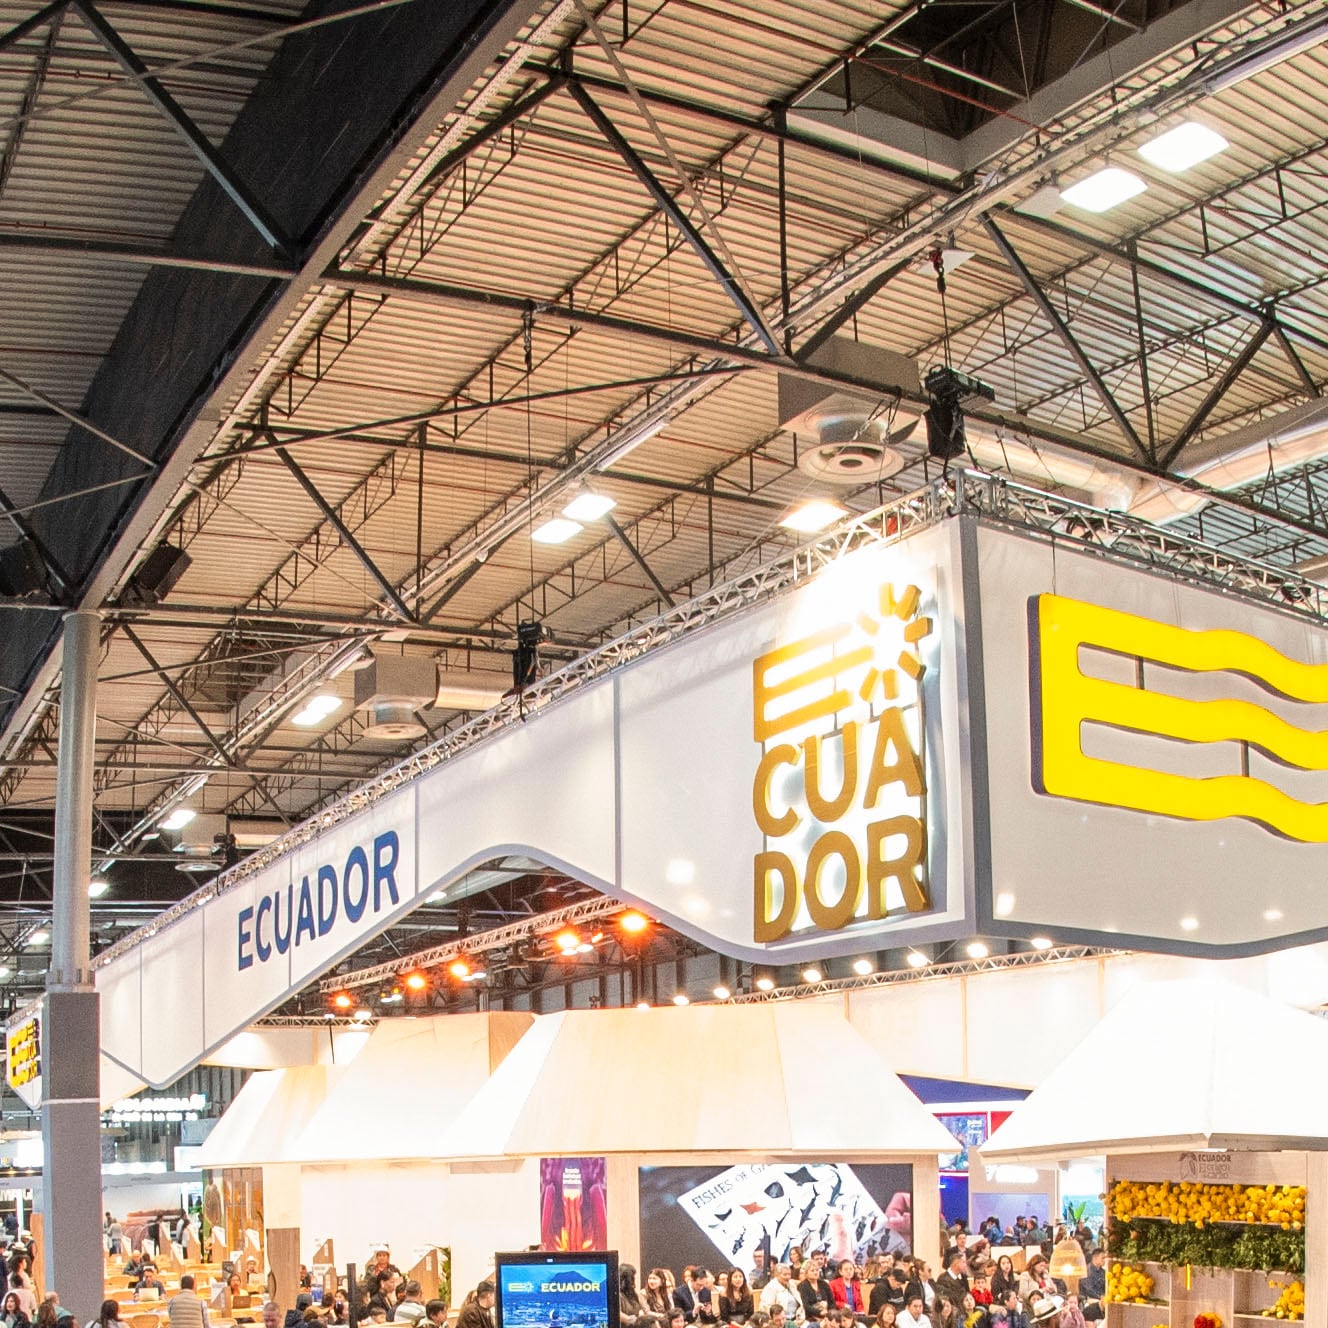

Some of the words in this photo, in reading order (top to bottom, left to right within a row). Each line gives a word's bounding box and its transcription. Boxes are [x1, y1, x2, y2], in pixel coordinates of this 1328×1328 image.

[754, 706, 927, 836] CUA
[238, 831, 400, 971] ECUADOR
[754, 813, 929, 943] DOR
[691, 1176, 734, 1209] FISHES
[541, 1282, 600, 1292] ECUADOR
